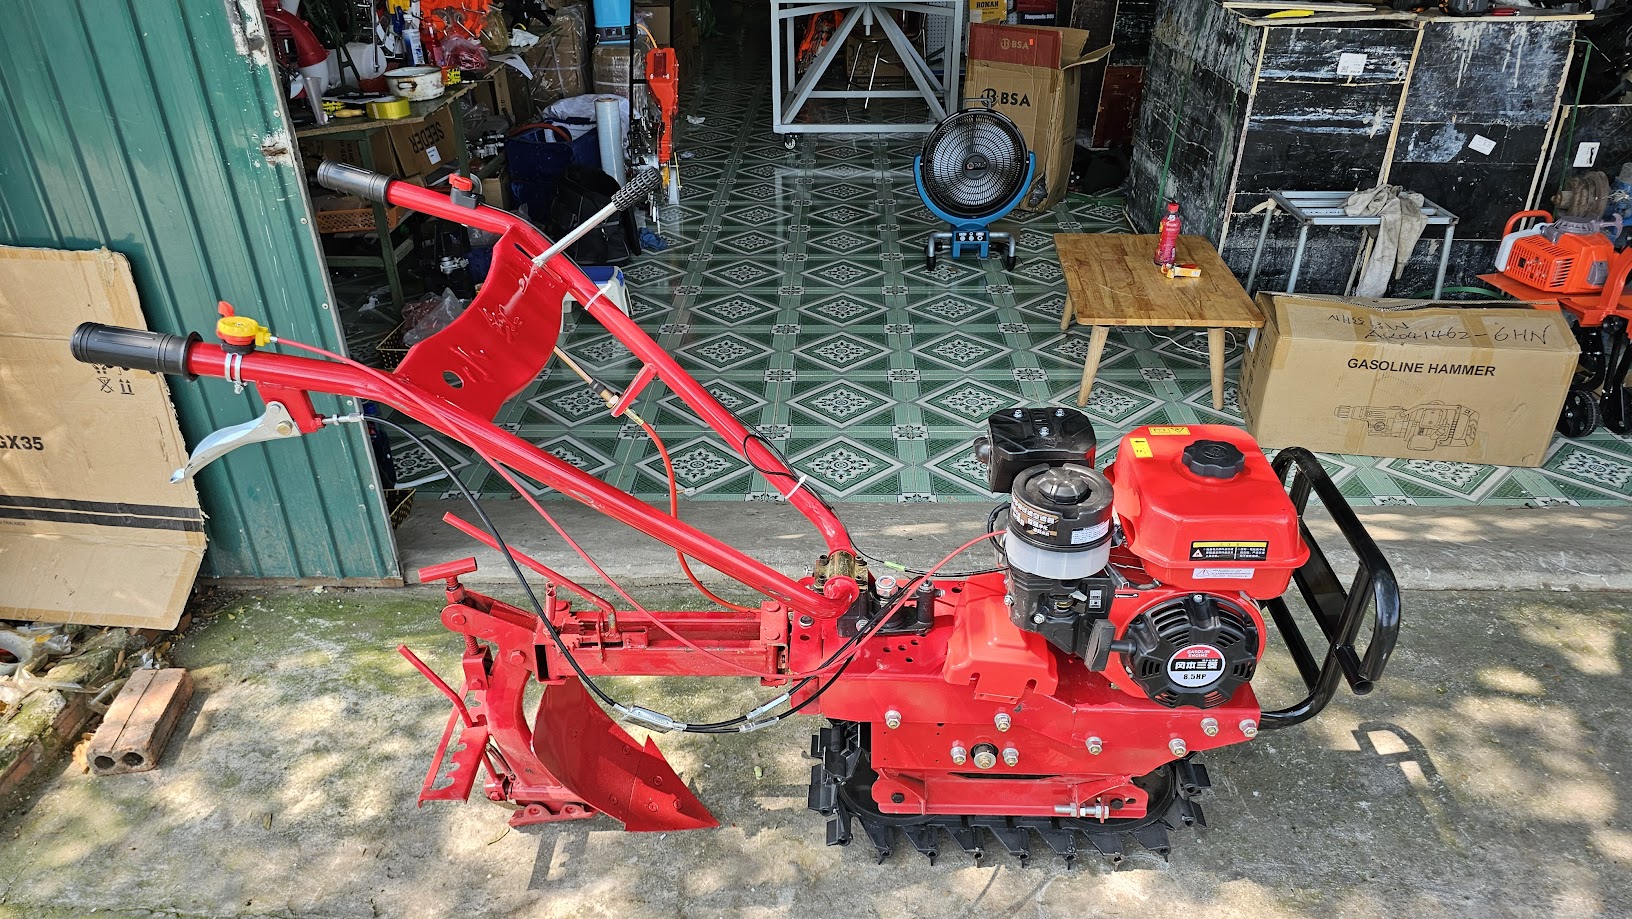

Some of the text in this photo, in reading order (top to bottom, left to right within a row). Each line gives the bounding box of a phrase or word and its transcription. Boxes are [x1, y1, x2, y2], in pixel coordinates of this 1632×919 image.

[1012, 41, 1029, 50] BSA
[1001, 92, 1030, 107] BSA
[408, 121, 445, 154] SEEDER
[1347, 358, 1496, 376] GASOLINE HAMMER
